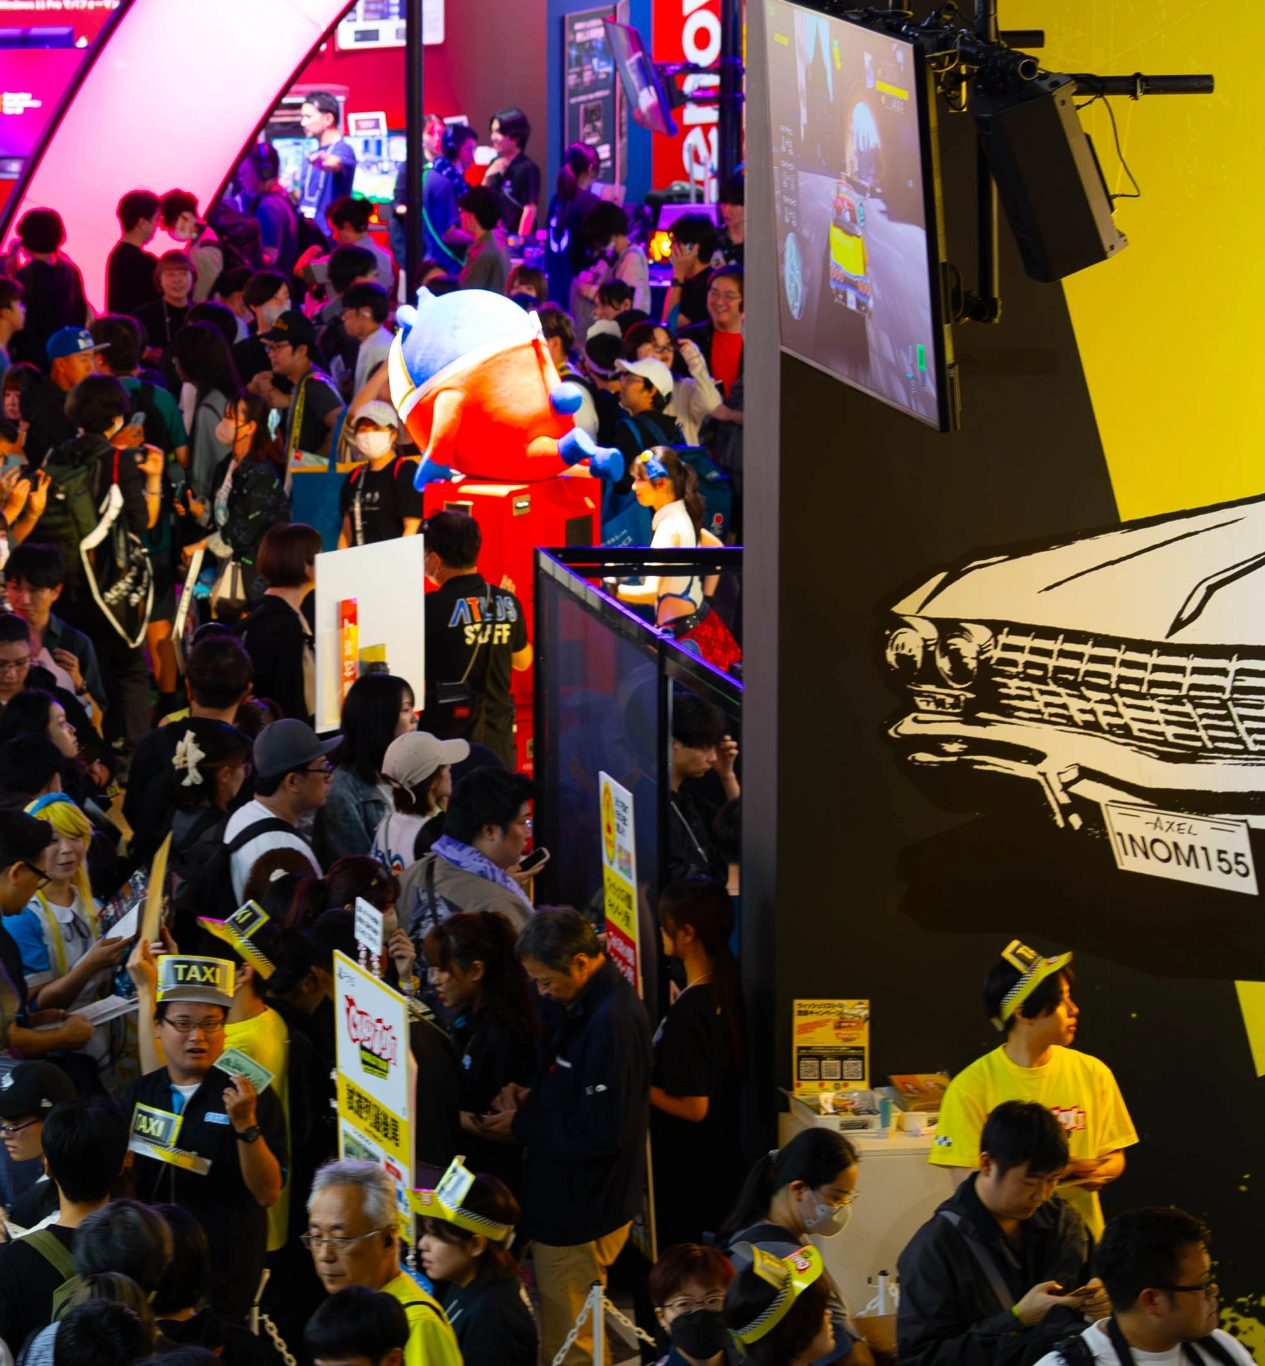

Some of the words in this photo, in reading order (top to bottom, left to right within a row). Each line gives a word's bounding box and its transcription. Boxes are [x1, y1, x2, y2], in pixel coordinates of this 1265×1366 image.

[1144, 815, 1199, 836] AXEL
[1115, 831, 1251, 878] 1NOM155
[173, 963, 221, 985] TAXI
[134, 1112, 167, 1139] TAXI
